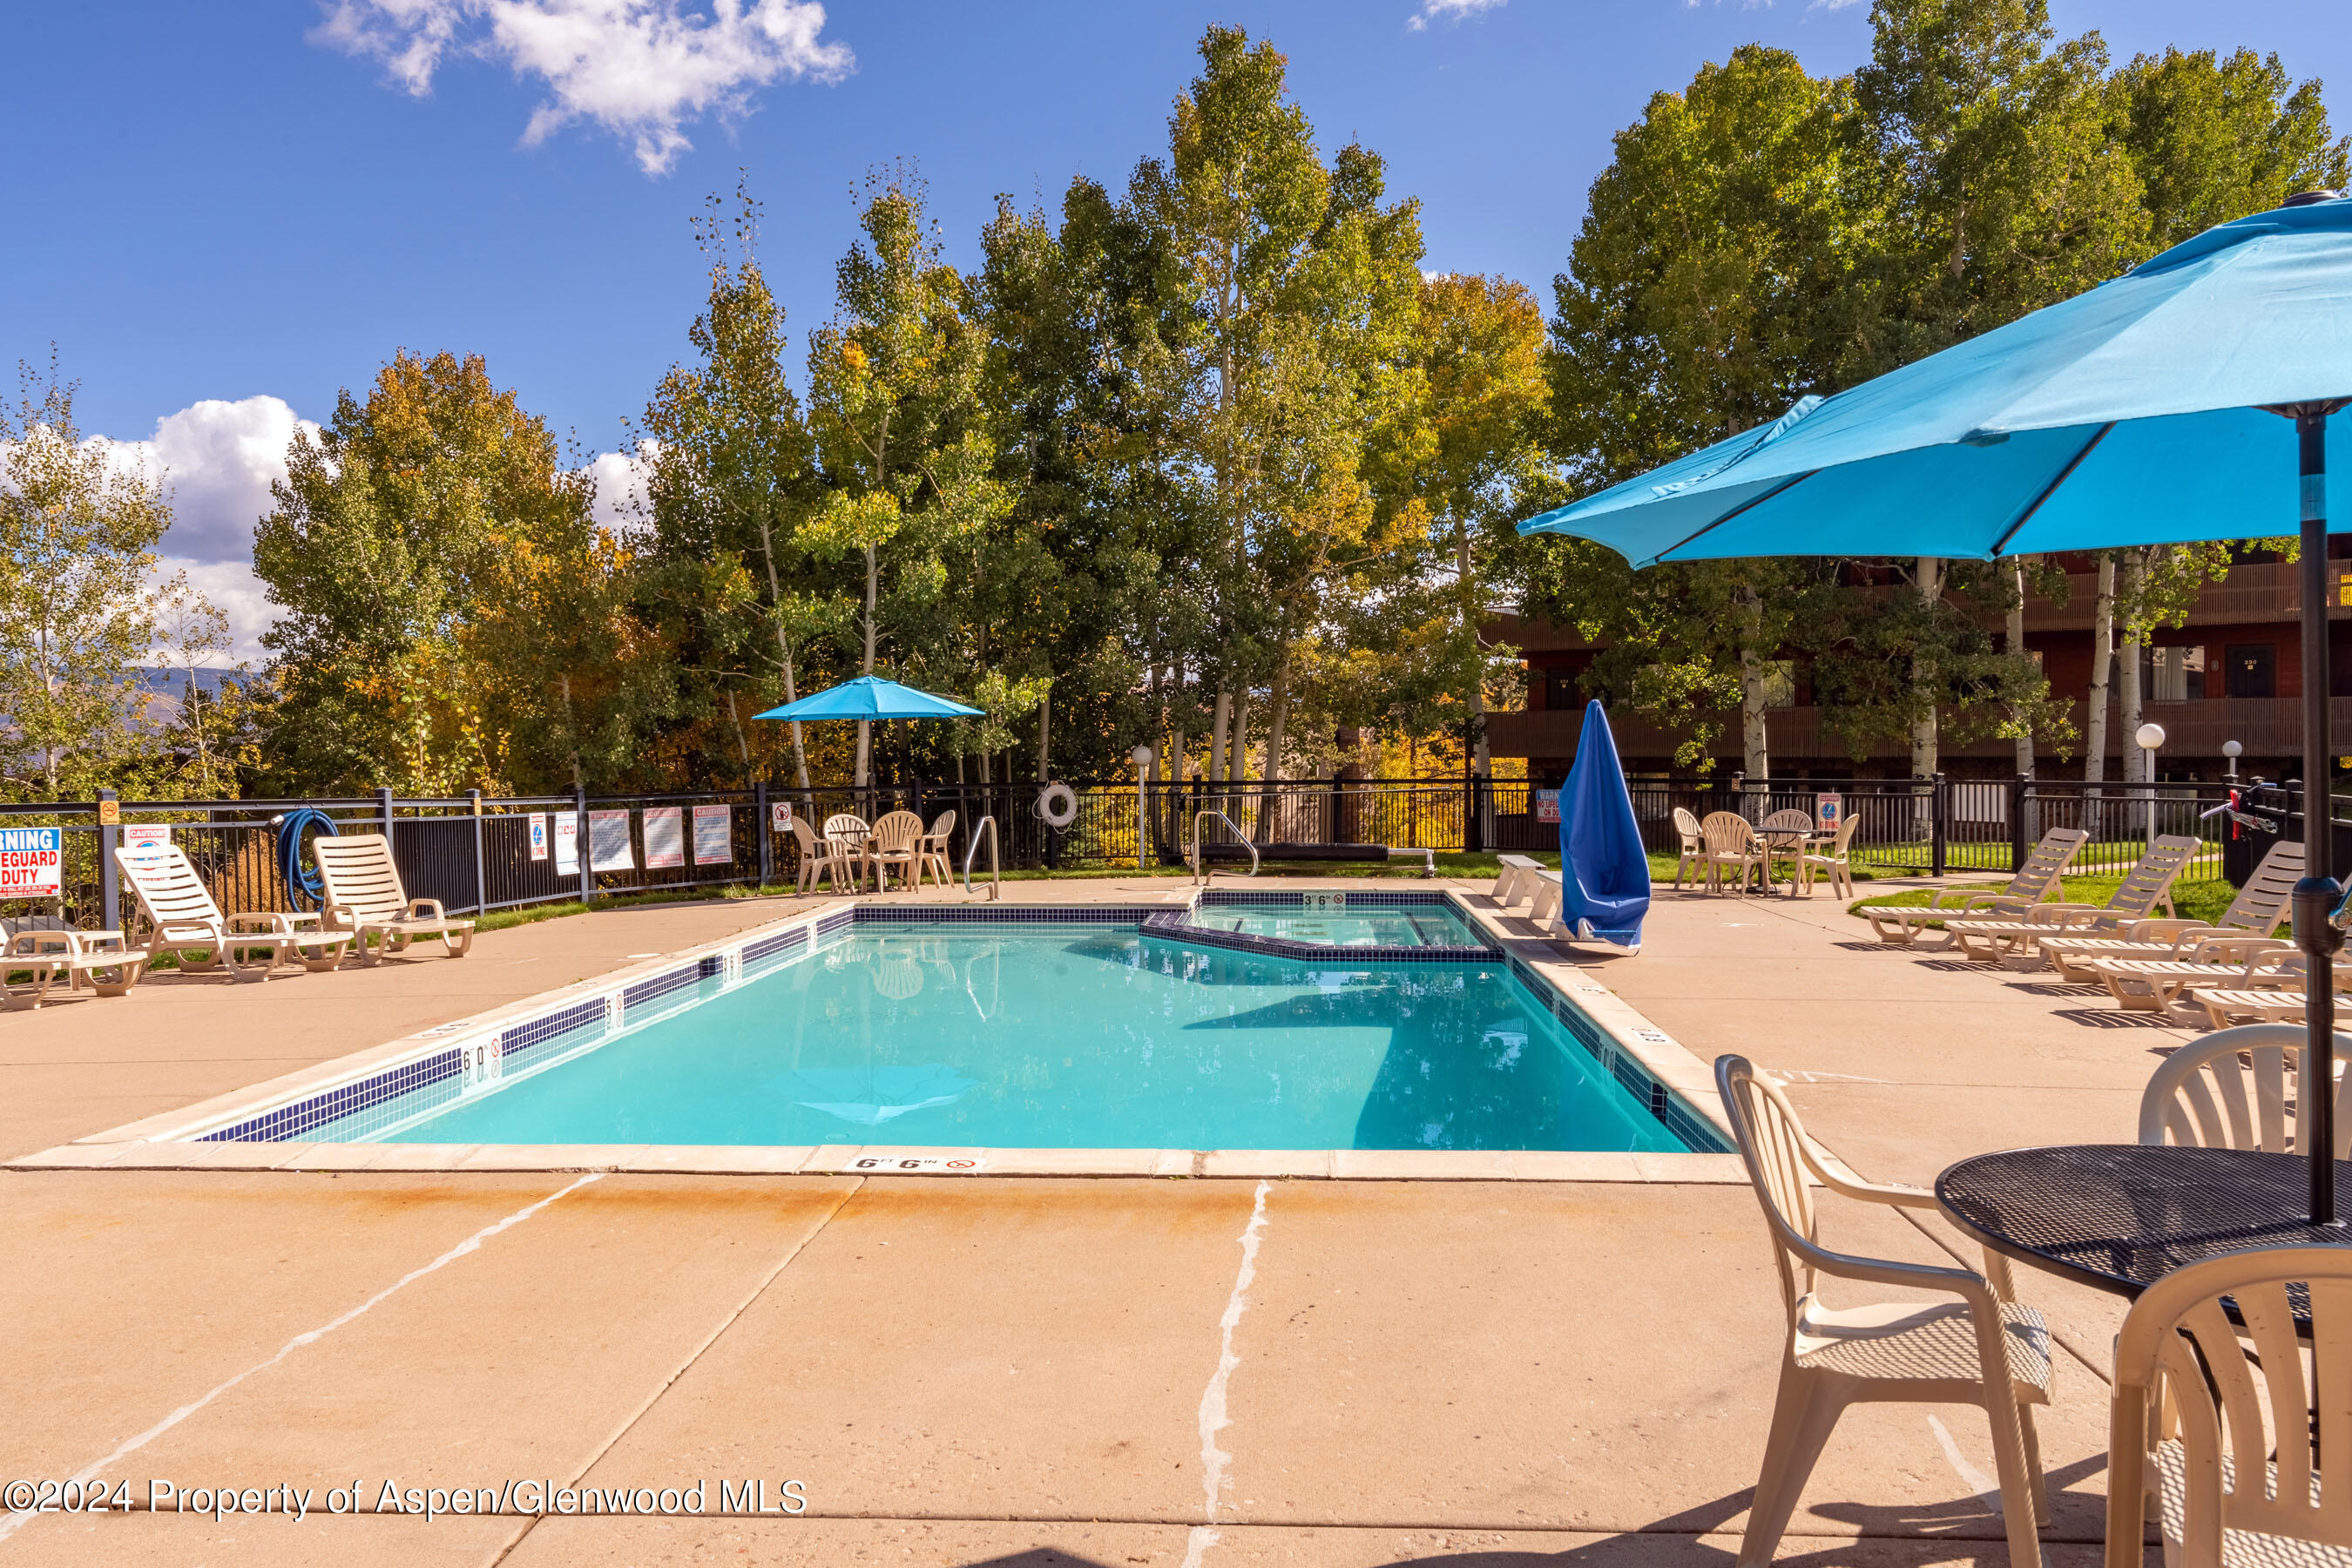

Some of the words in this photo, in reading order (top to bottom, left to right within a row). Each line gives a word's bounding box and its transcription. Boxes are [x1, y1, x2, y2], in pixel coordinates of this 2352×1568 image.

[1, 851, 57, 868] EGUARD
[2, 868, 38, 885] DUTY
[1305, 896, 1311, 905] 3
[1319, 896, 1325, 905] 6
[606, 999, 612, 1016] 5
[463, 1051, 470, 1070] 6
[476, 1046, 483, 1065] 0
[855, 1159, 879, 1168] 6
[899, 1159, 922, 1169] 6
